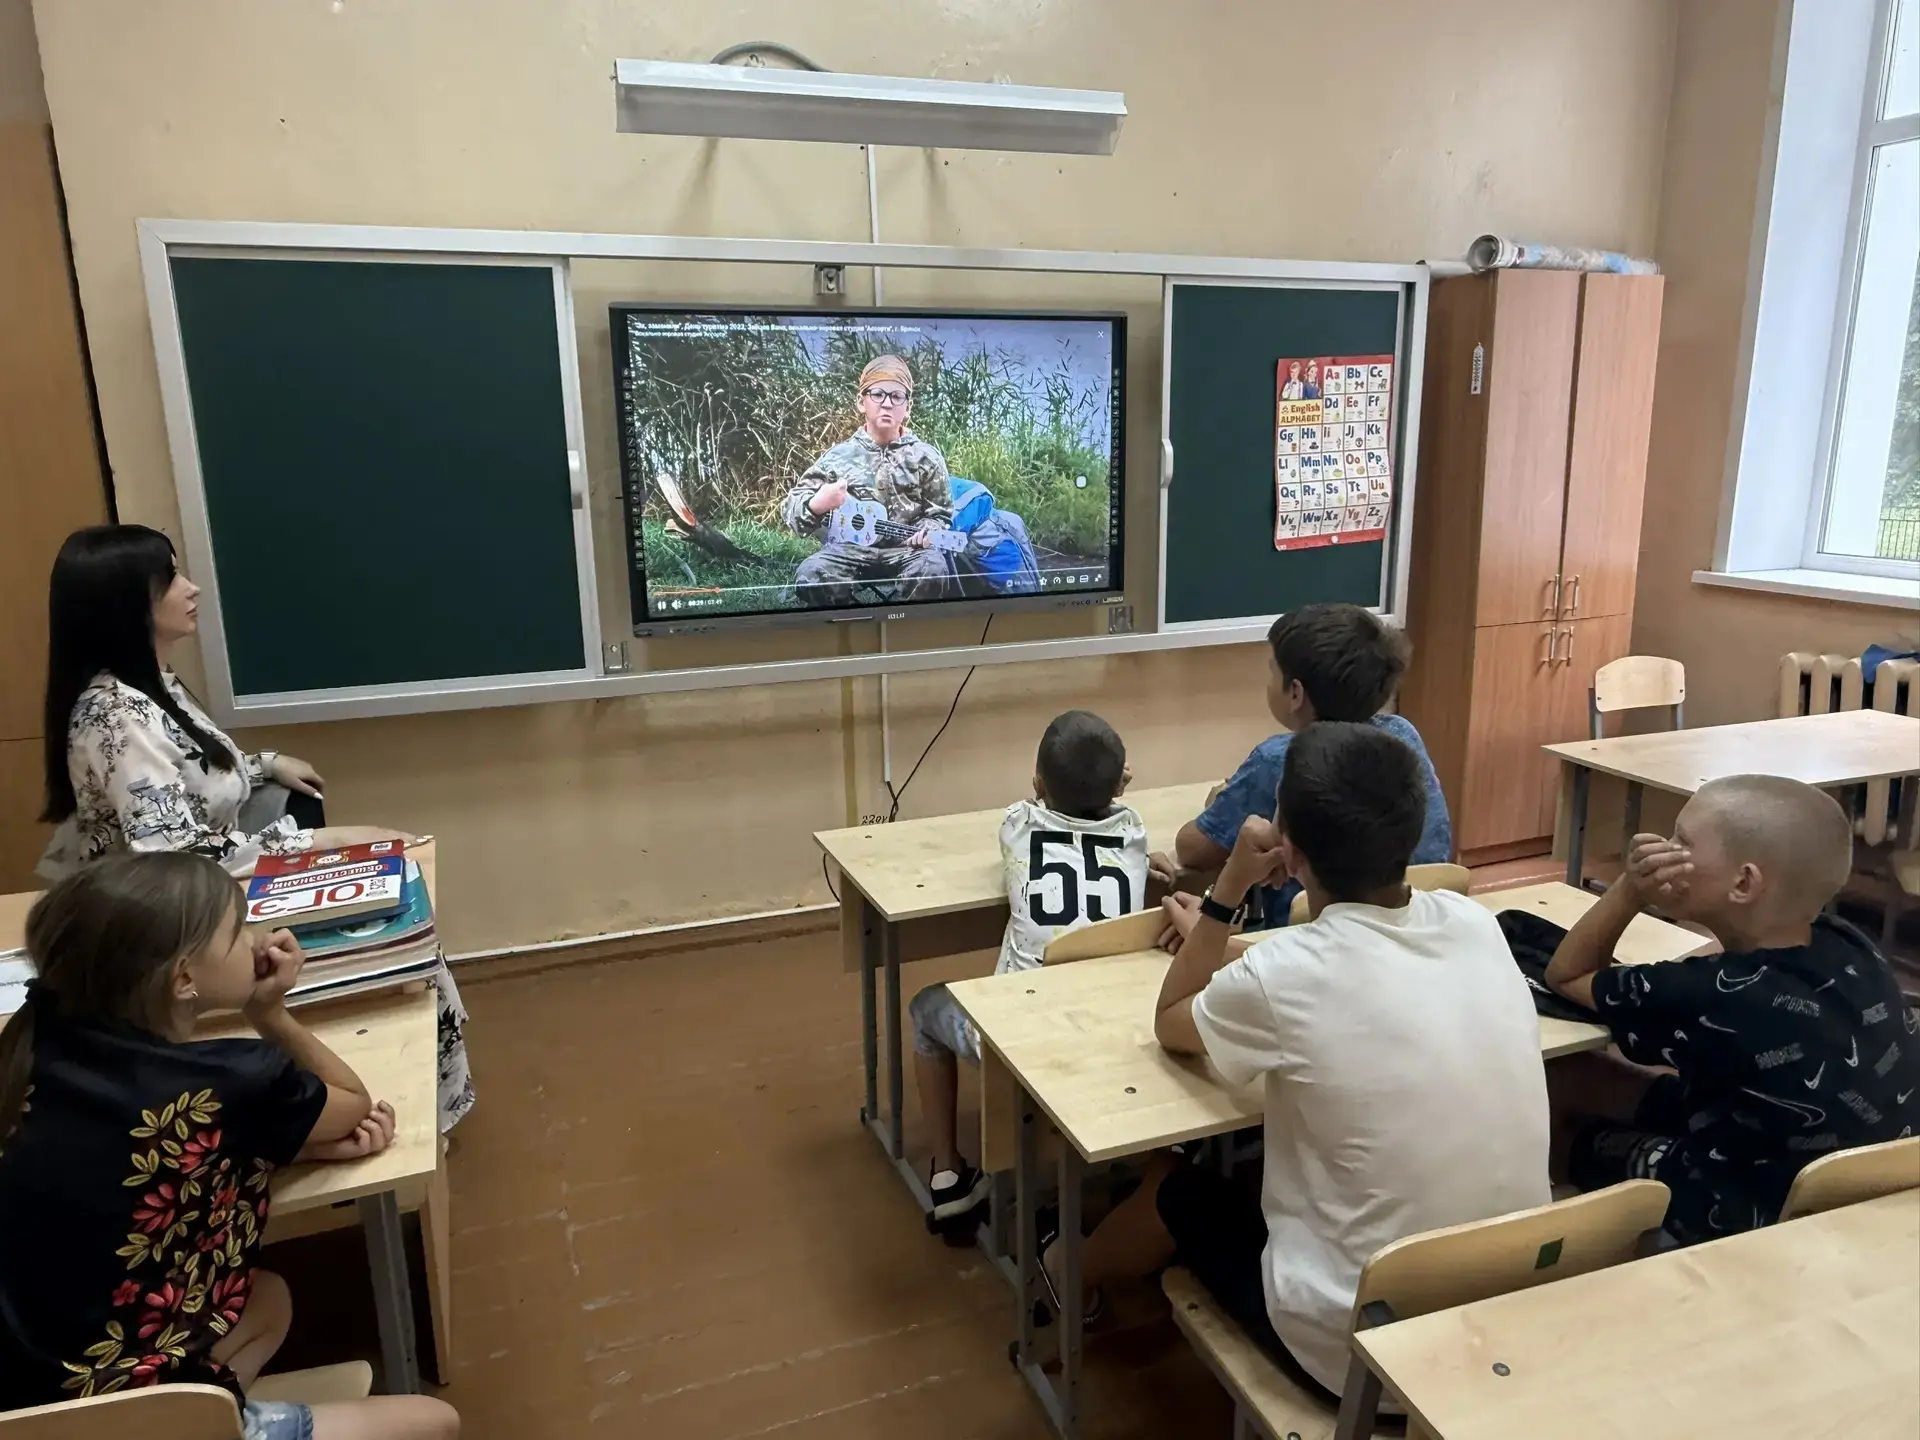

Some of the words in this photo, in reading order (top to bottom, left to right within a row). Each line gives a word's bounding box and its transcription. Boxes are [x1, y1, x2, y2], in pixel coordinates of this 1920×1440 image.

[1326, 368, 1340, 379] Aa
[1347, 367, 1360, 378] Bb
[1370, 366, 1383, 377] Cc
[1291, 403, 1320, 414] English
[1325, 397, 1339, 408] Dd
[1346, 397, 1359, 407] Ee
[1368, 395, 1380, 406] Ff
[1281, 415, 1320, 424] ALPHABET
[1280, 429, 1294, 442] Gg
[1302, 428, 1316, 439] Hh
[1345, 425, 1355, 438] Jj
[1367, 424, 1381, 435] Kk
[1301, 457, 1320, 467] Mm
[1323, 455, 1338, 466] Nn
[1345, 454, 1360, 464] Oo
[1368, 452, 1382, 464] Pp
[1281, 487, 1295, 499] Qq
[1303, 485, 1316, 496] Rr
[1326, 483, 1339, 494] Ss
[1348, 481, 1361, 492] Tt
[1371, 479, 1385, 490] Uu
[1280, 515, 1294, 526] Vv
[1303, 513, 1320, 523] Ww
[1347, 509, 1360, 520] Yy
[1368, 507, 1380, 517] Zz
[1029, 830, 1132, 926] 55
[250, 882, 365, 917] ОГЭ
